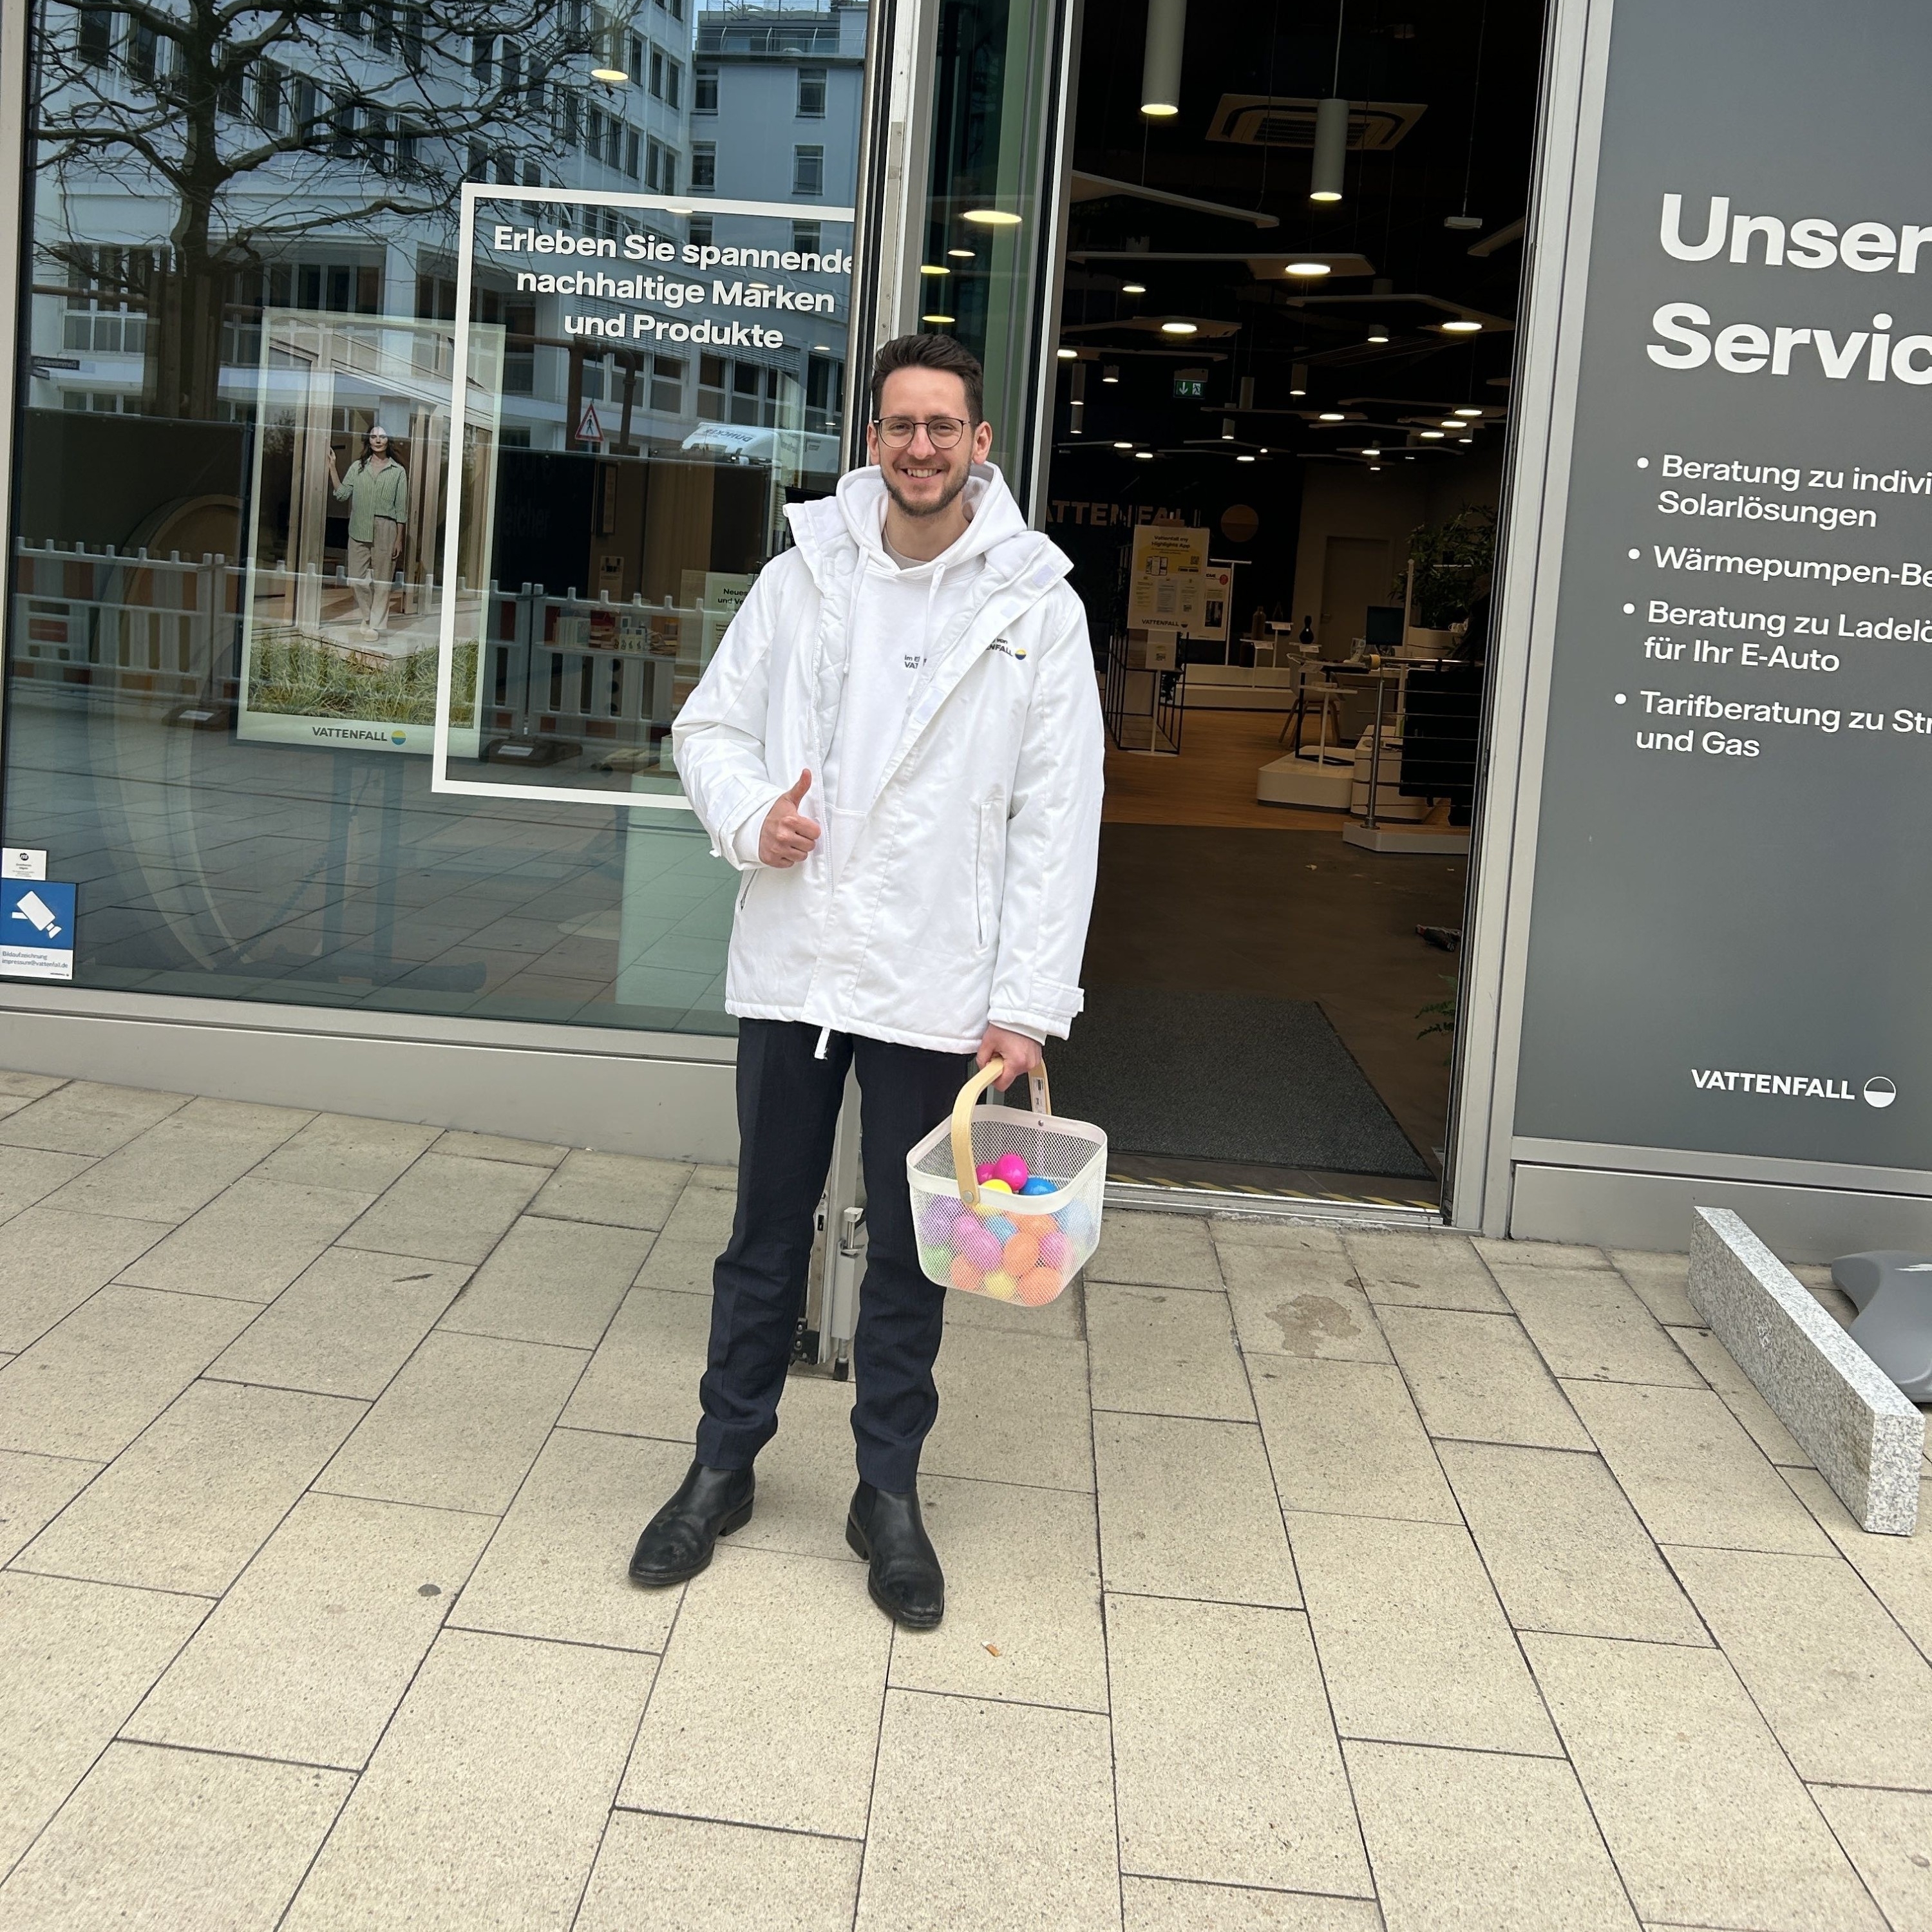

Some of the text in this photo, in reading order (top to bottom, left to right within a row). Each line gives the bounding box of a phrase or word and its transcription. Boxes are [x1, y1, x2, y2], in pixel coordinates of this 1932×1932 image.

[493, 225, 616, 258] Erleben
[622, 234, 675, 262] Sie
[1660, 193, 1932, 274] Unser
[516, 270, 835, 314] nachhaltige Marken
[564, 314, 784, 349] und Produkte
[1647, 303, 1932, 385] Servic
[1662, 454, 1932, 495] Beratung zu indivi
[1658, 490, 1877, 531] Solarlösungen
[1648, 600, 1932, 643] Beratung zu Ladelö
[1643, 636, 1840, 672] für Ihr E-Auto
[1640, 690, 1841, 733] Tarifberatung
[1848, 712, 1884, 730] zu
[312, 726, 388, 741] VATTENFALL
[1636, 730, 1760, 757] und Gas
[1691, 1069, 1855, 1100] VATTENFALL
